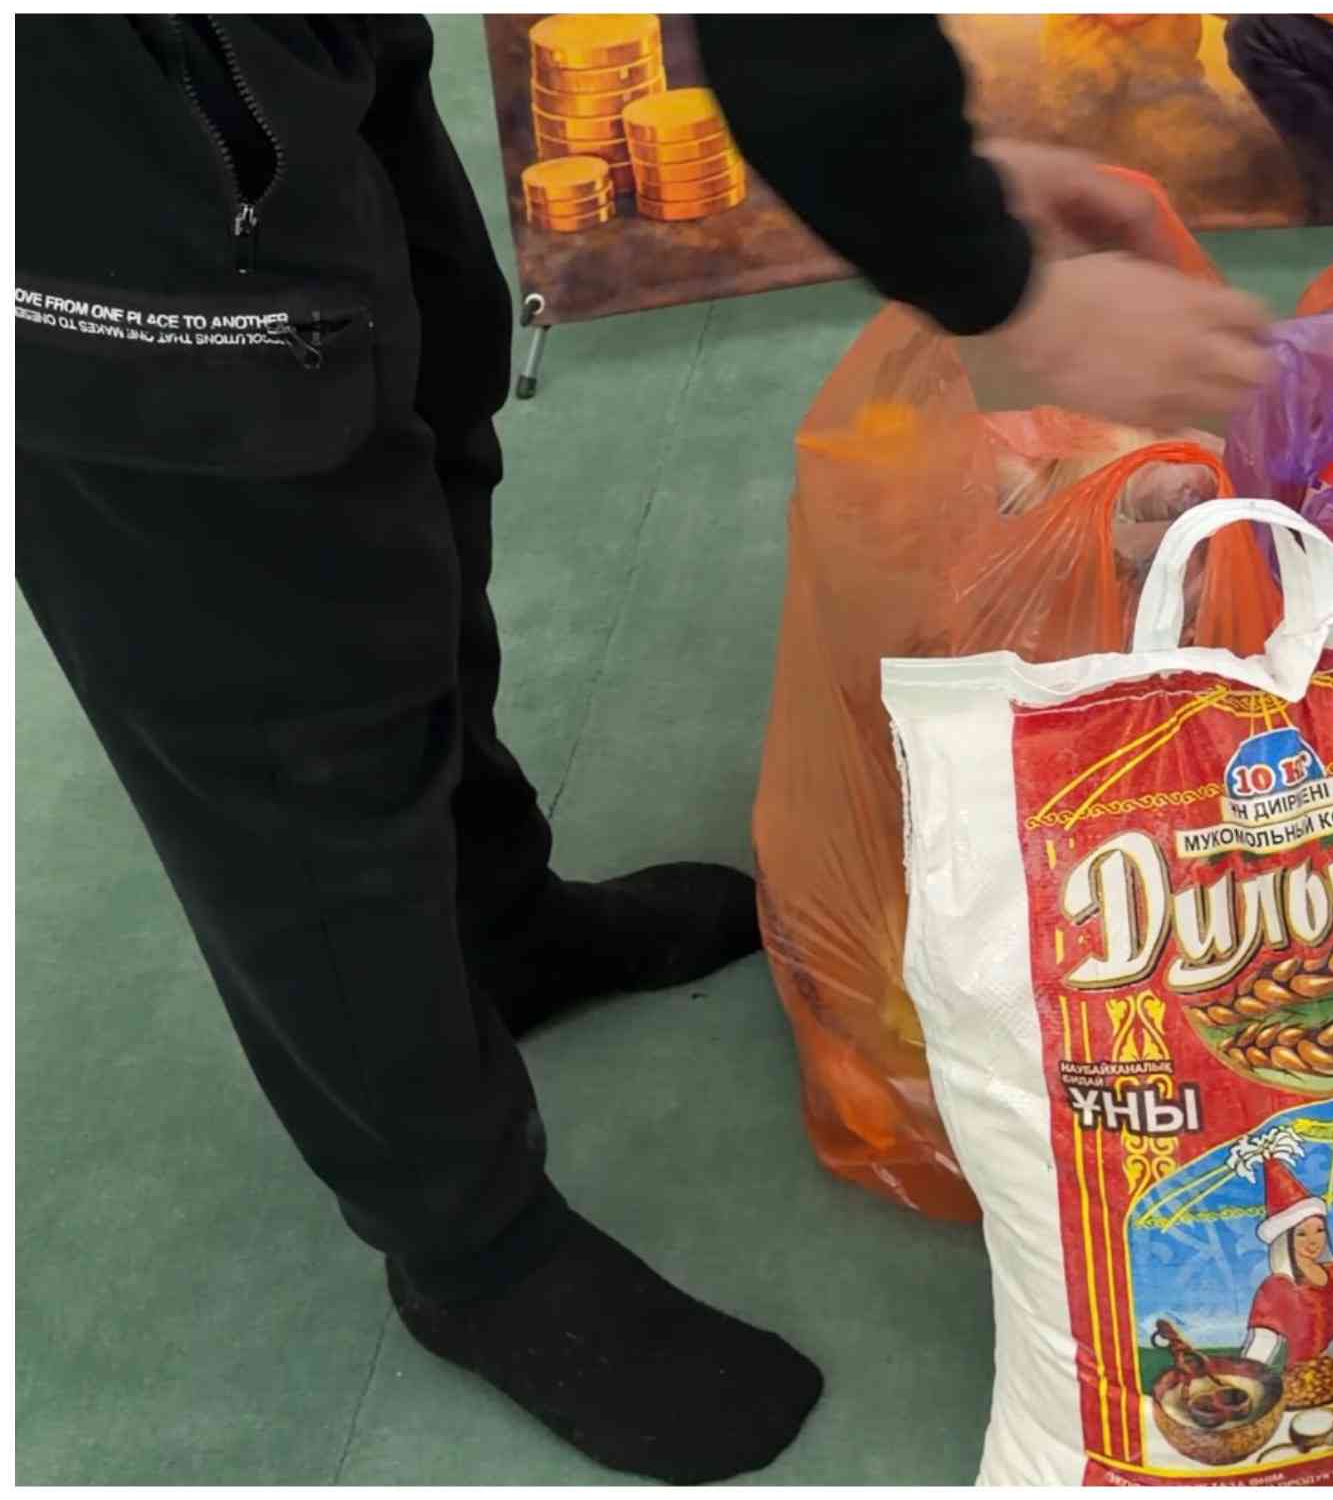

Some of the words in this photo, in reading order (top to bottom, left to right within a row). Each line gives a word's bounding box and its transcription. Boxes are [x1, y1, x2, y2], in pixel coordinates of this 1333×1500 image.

[15, 288, 43, 308] OVE
[45, 295, 90, 317] FROM
[91, 304, 124, 323] ONE
[182, 314, 208, 330] TO
[57, 316, 79, 332] TO
[1231, 764, 1276, 797] 10
[1068, 1086, 1200, 1134] ҰНЫ
